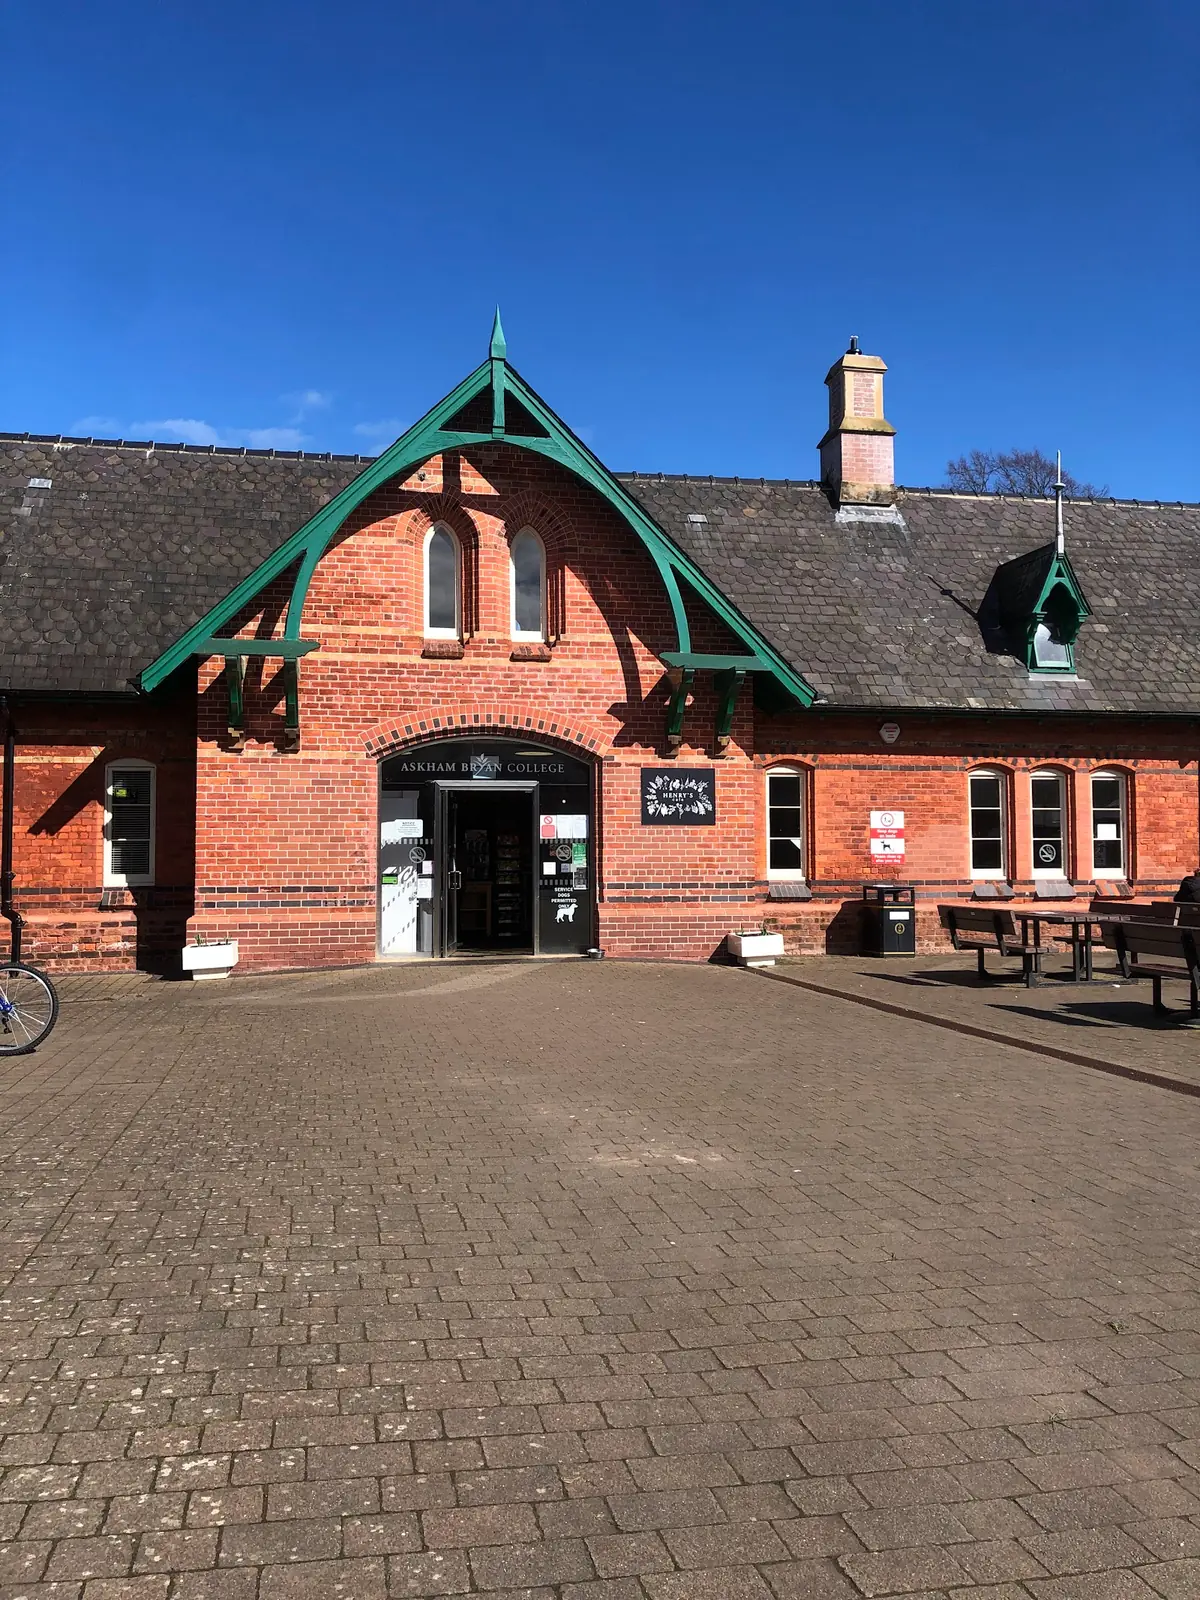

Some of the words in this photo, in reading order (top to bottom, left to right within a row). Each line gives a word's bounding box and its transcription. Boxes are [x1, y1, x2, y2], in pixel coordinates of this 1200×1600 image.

[401, 762, 456, 772] ASKHAM
[461, 760, 502, 775] BRYAN
[507, 763, 565, 773] COLLEGE
